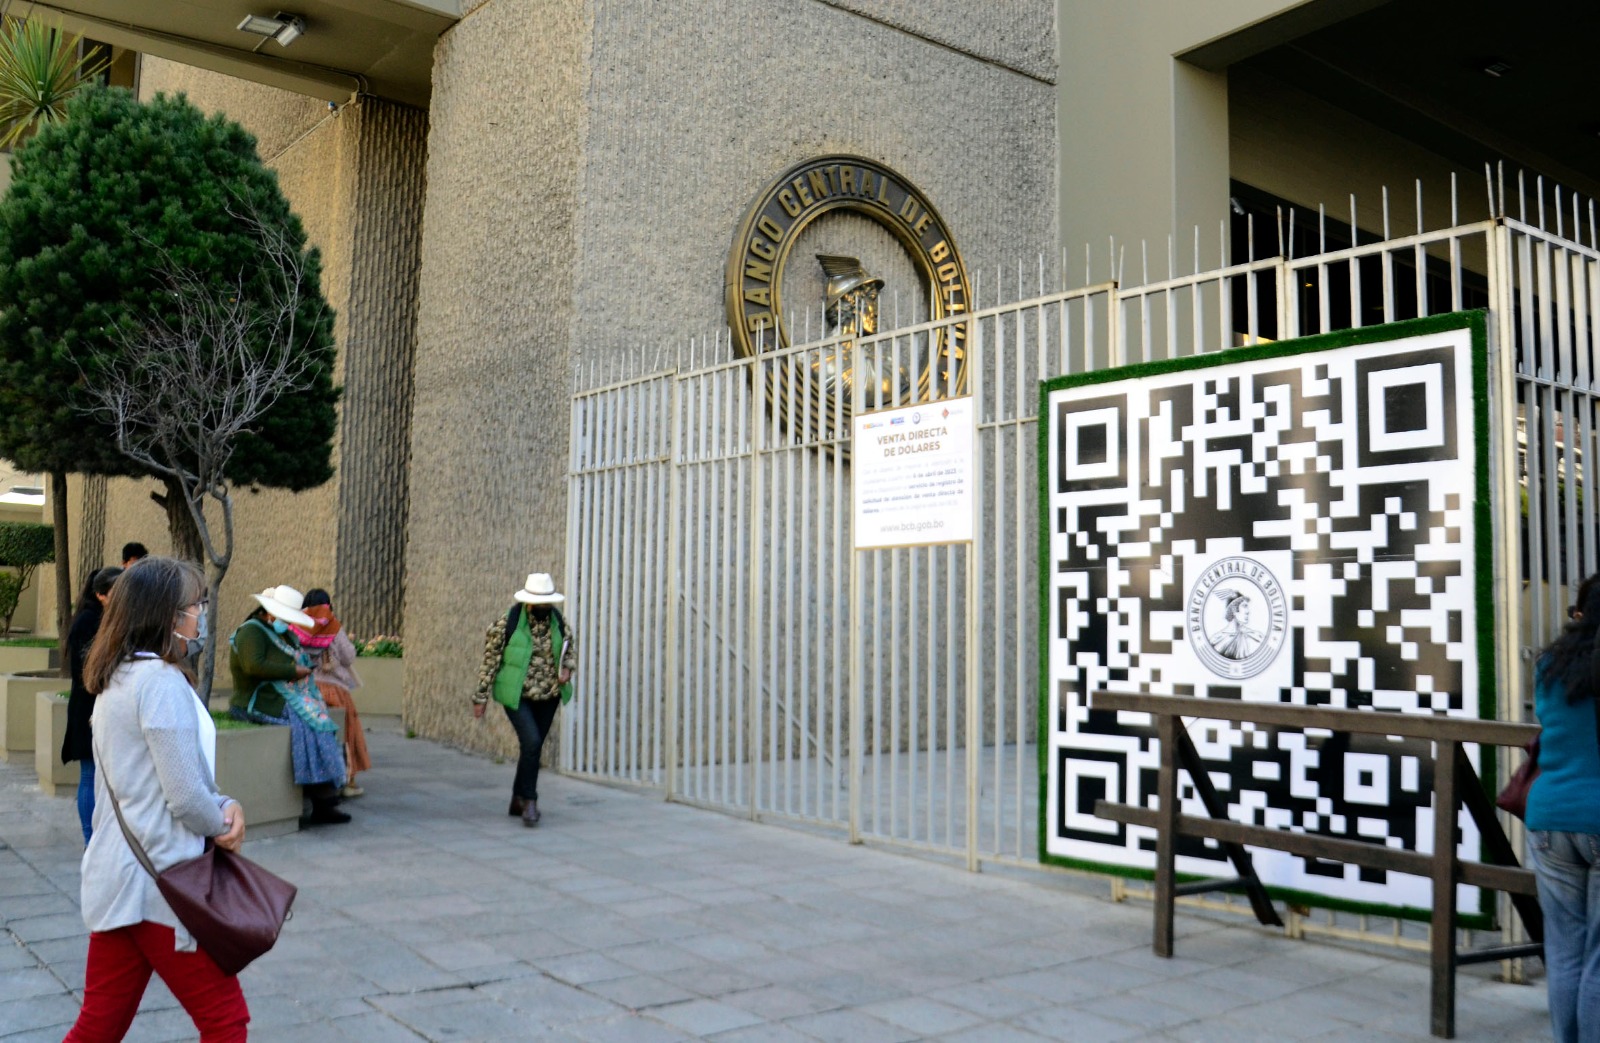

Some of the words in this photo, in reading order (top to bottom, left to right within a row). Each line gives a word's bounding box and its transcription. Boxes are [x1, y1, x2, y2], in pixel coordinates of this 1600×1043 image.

[744, 214, 784, 333] BANCO
[777, 164, 890, 218] CENTRAL
[898, 194, 934, 237] DE
[877, 433, 906, 445] VENTA
[908, 426, 948, 440] DIRECTA
[884, 447, 896, 457] DE
[1190, 589, 1205, 632] BANCO
[1202, 561, 1246, 588] CENTRAL
[1250, 566, 1265, 580] DE
[1263, 579, 1283, 632] BOLIVIA
